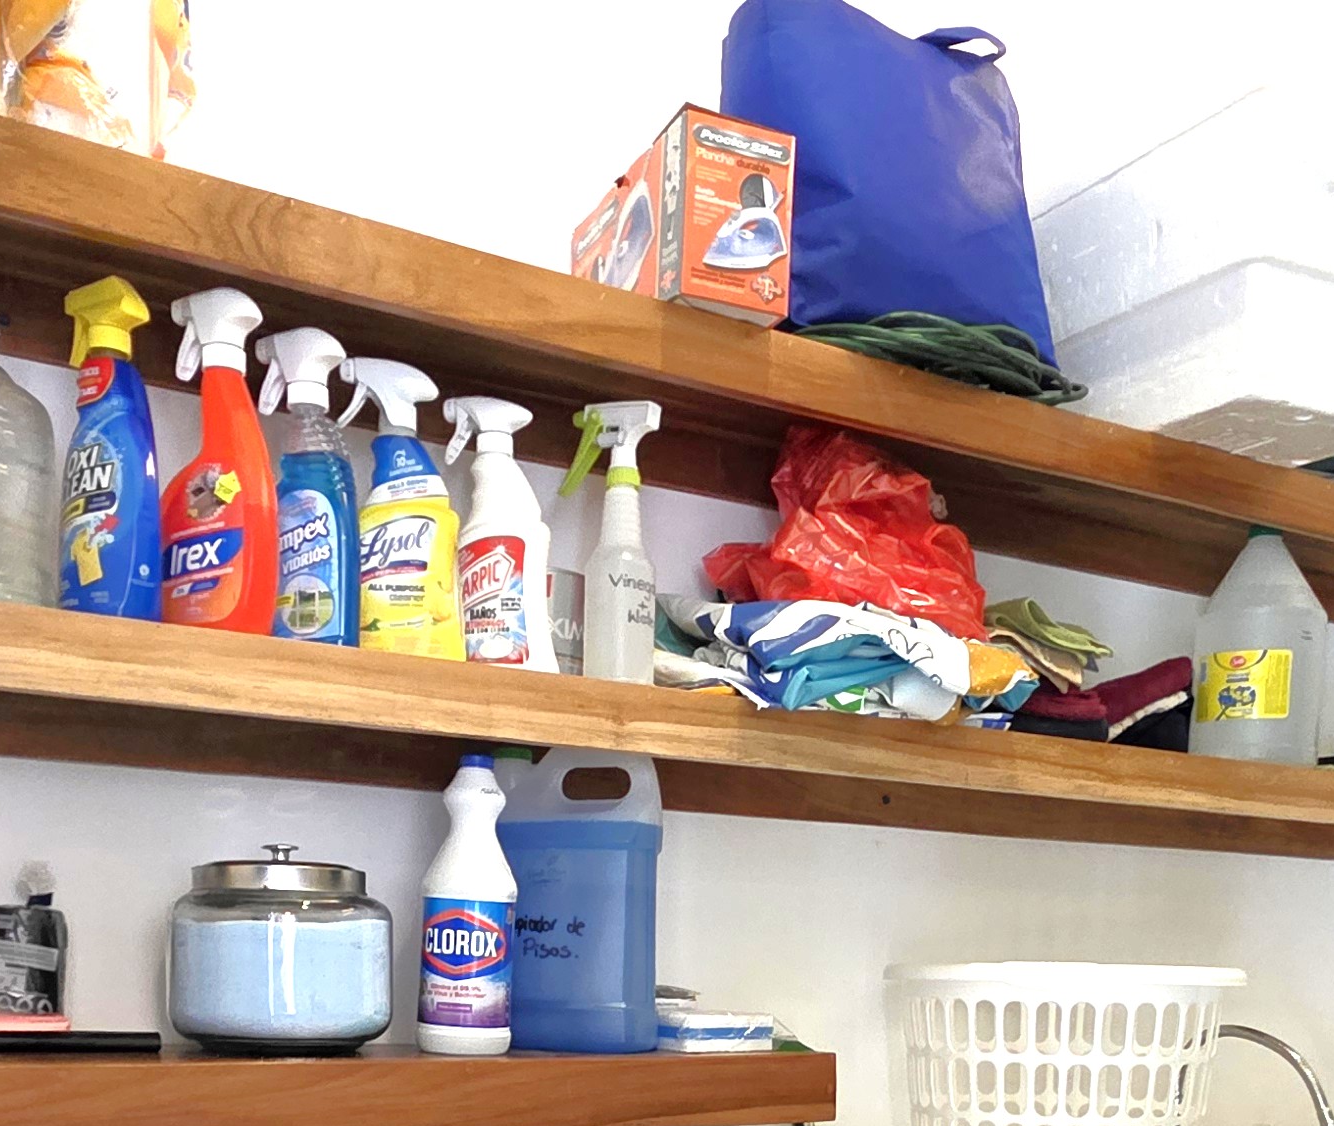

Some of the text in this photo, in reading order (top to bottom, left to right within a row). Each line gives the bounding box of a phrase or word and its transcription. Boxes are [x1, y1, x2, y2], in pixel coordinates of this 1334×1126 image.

[700, 128, 784, 159] Proctor Silex
[695, 146, 735, 167] Plancha
[736, 158, 771, 175] durable
[68, 445, 100, 479] OXI
[69, 463, 114, 497] EAN
[279, 514, 329, 551] mpex
[360, 521, 430, 567] Lysol
[170, 537, 223, 576] Irex
[283, 544, 331, 575] VIDRIOS
[368, 583, 426, 593] ALL PURPOSE
[462, 560, 502, 603] ARPIC
[470, 606, 498, 620] BAÑOS
[567, 915, 586, 937] de
[425, 927, 499, 958] CLOROX
